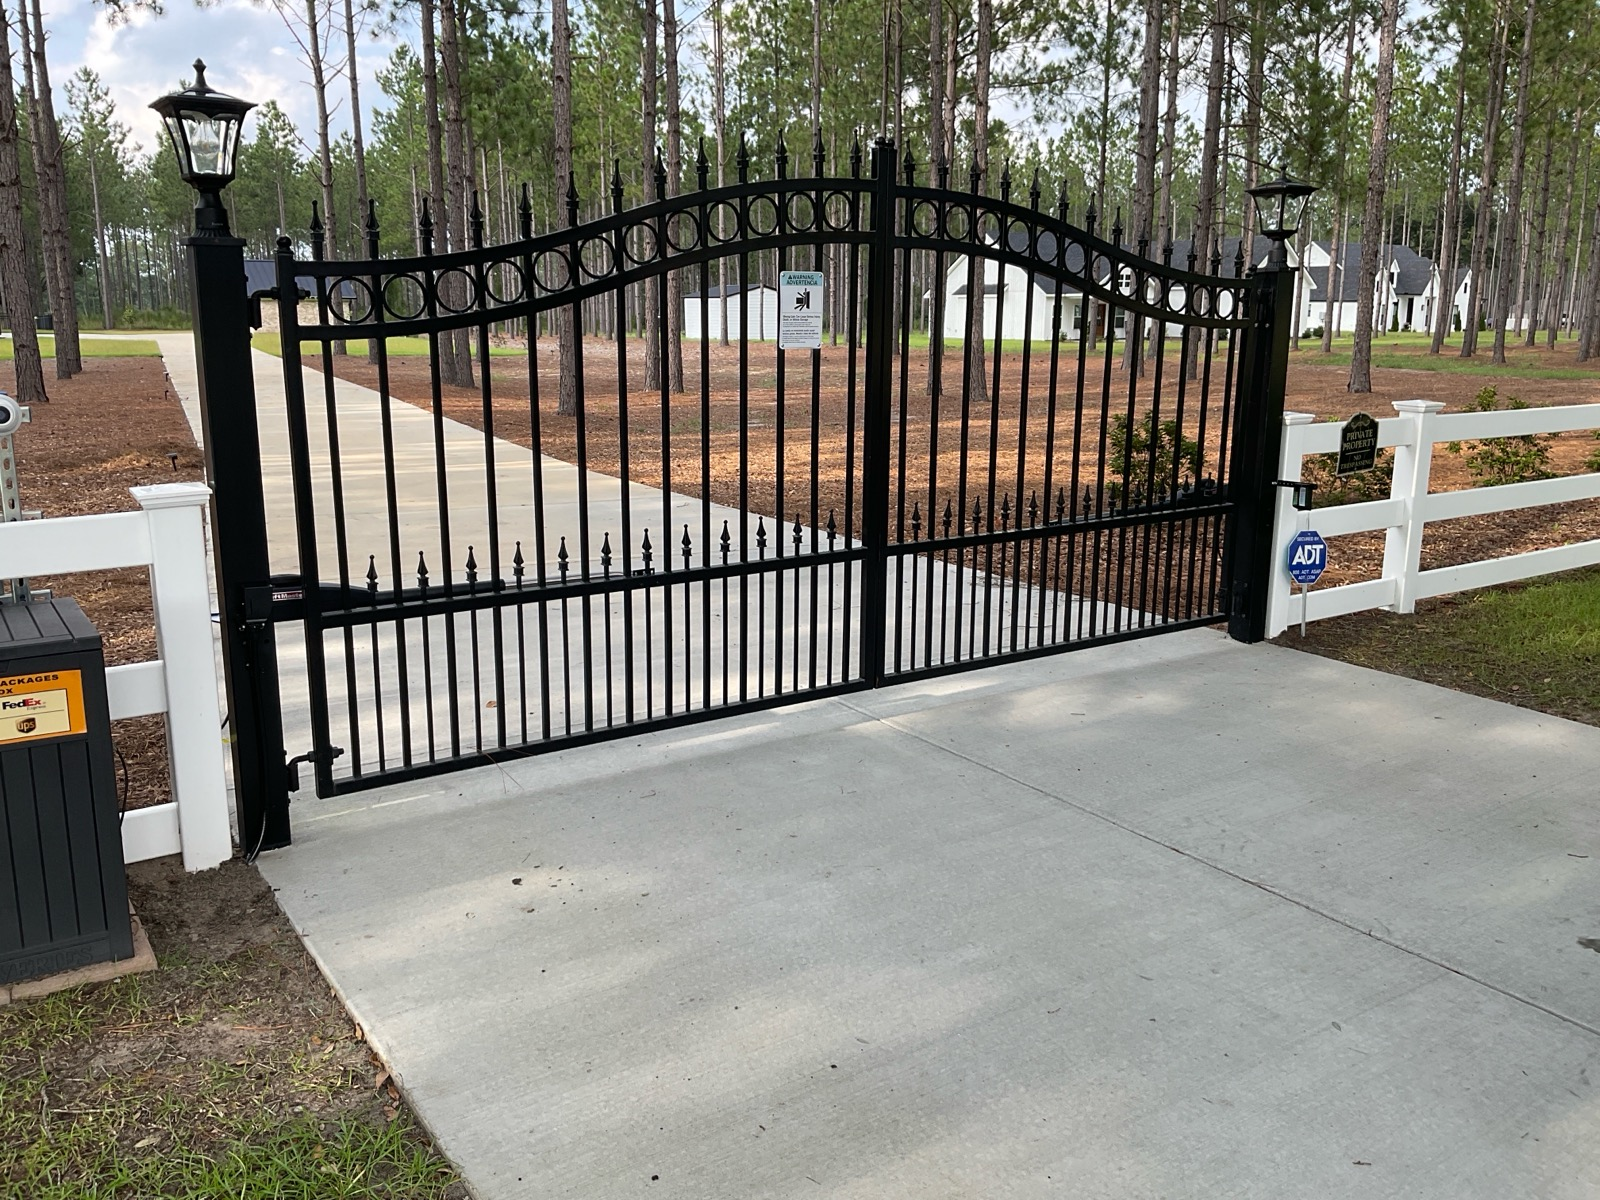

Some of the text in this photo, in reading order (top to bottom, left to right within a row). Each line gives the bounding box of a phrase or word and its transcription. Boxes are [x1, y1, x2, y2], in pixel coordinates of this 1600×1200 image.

[1346, 429, 1374, 441] PRIVATE
[1342, 438, 1376, 451] PROPERTY
[1291, 544, 1324, 566] ADT
[2, 698, 42, 710] FedEx
[17, 721, 35, 732] ups
